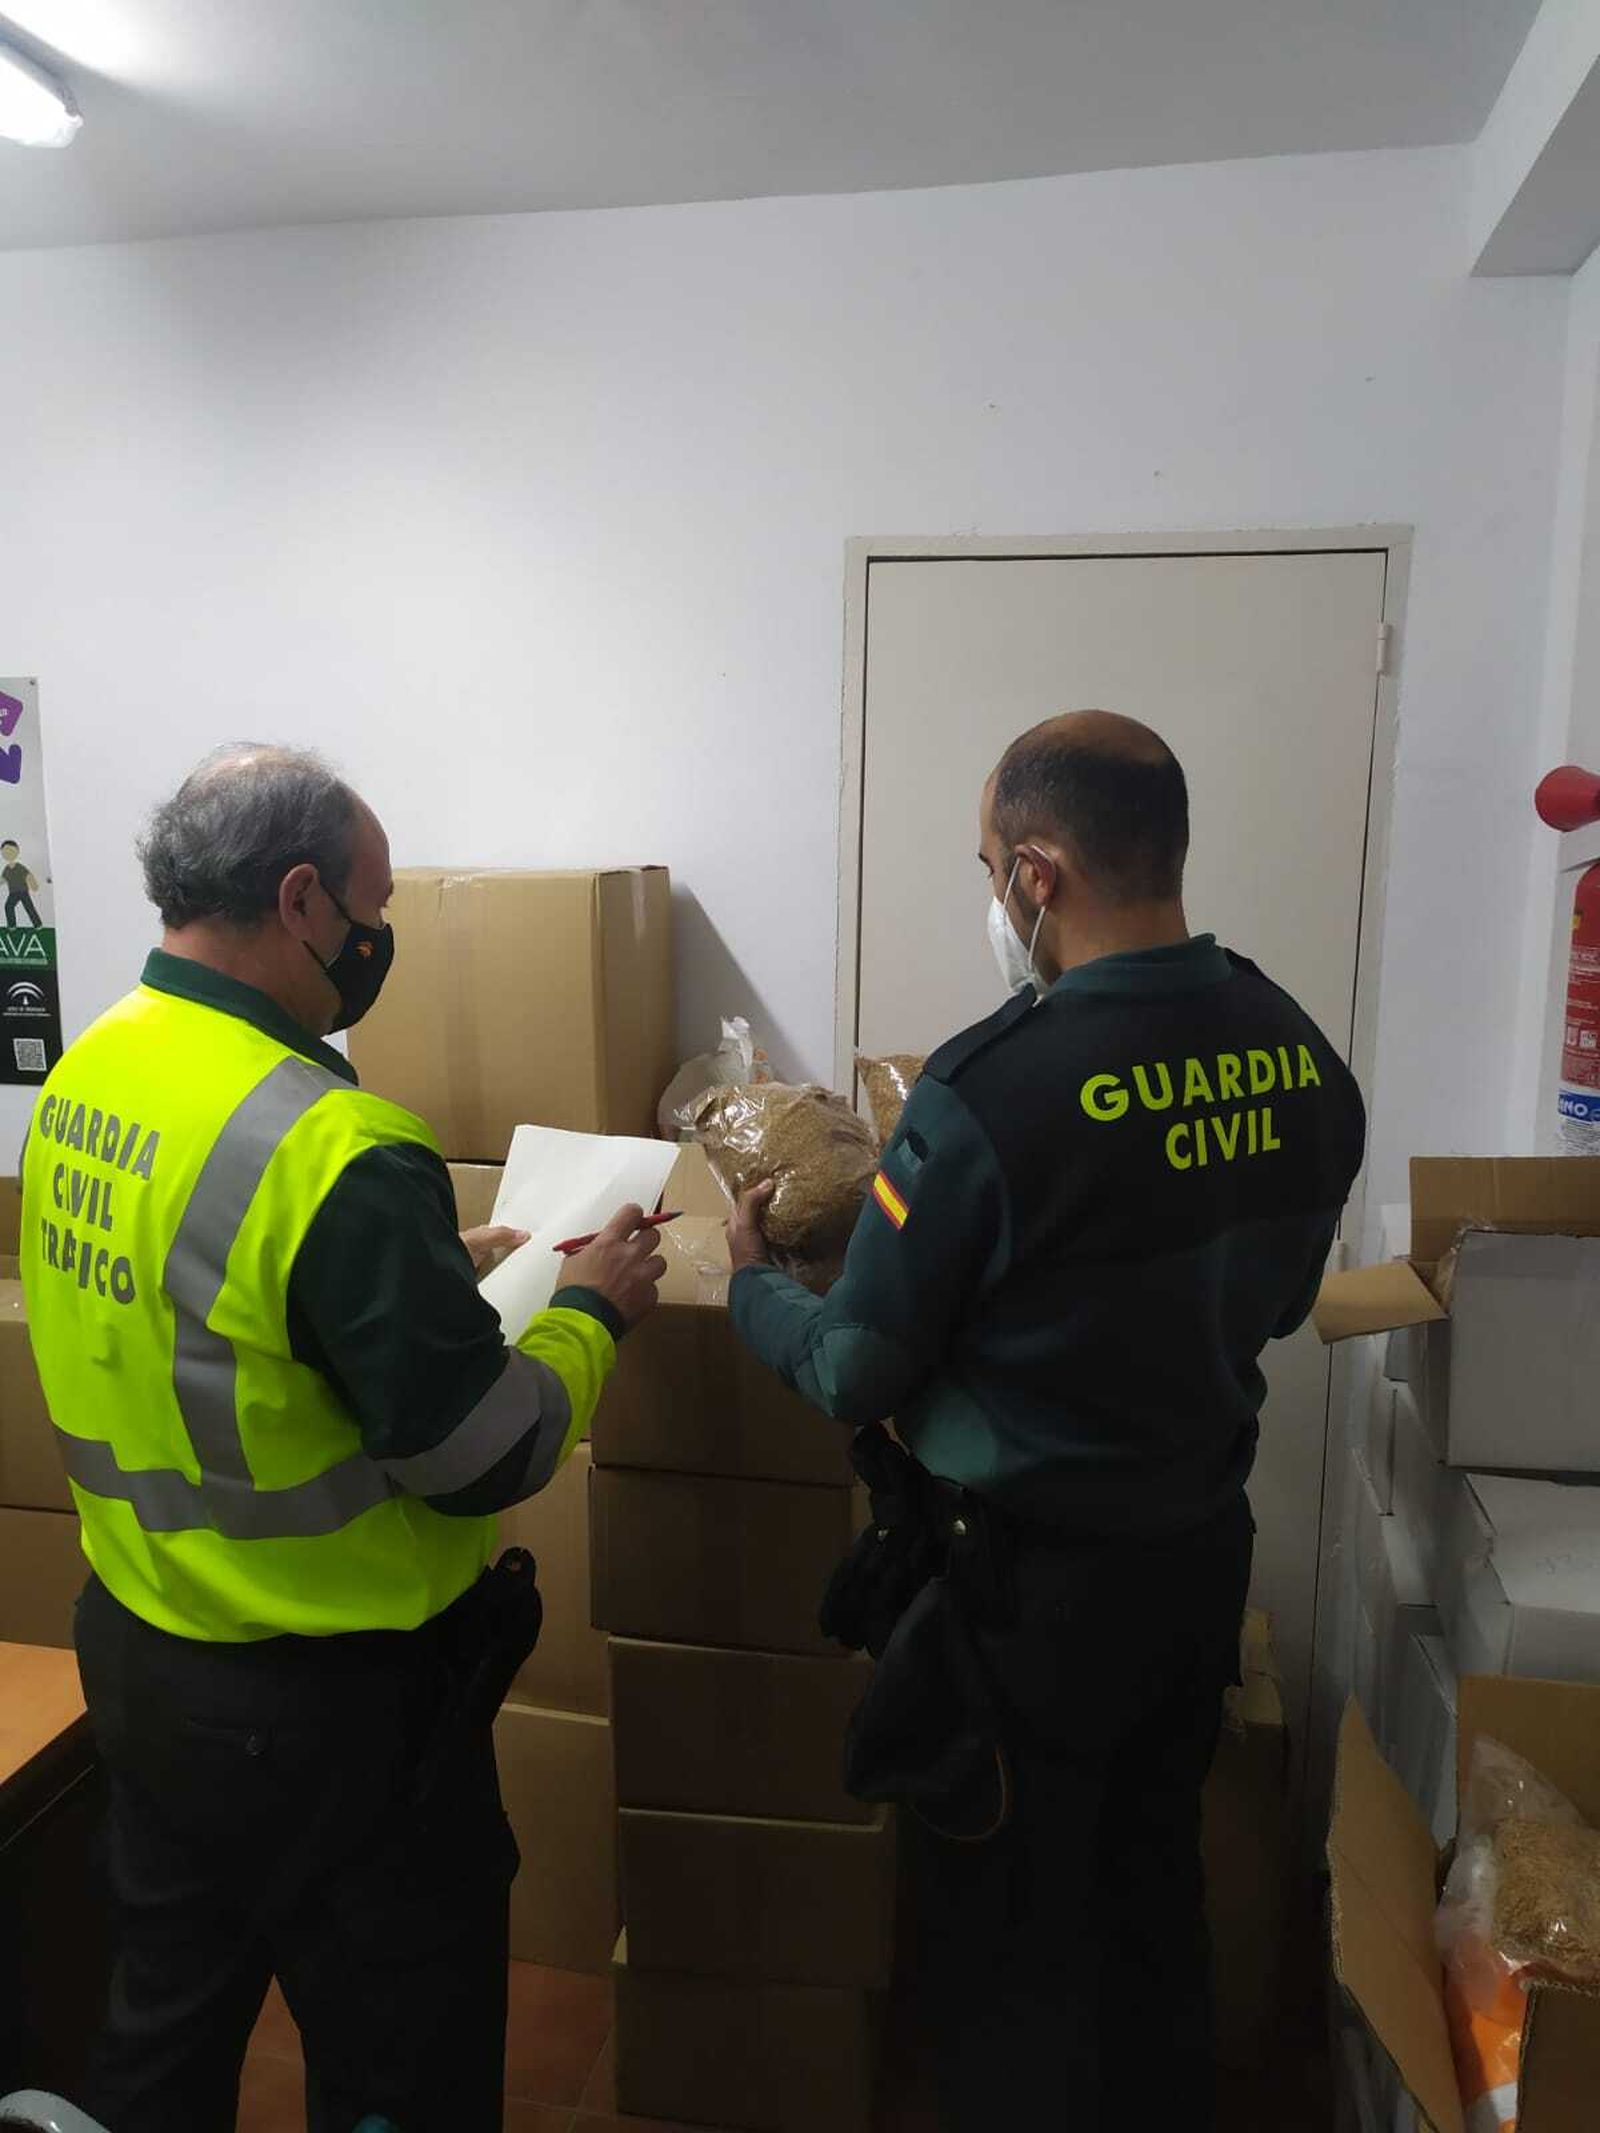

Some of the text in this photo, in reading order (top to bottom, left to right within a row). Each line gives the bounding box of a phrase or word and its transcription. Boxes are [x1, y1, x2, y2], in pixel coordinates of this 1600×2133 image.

[1080, 1044, 1321, 1121] GUARDIA
[39, 1093, 160, 1180] GUARDIA
[1165, 1107, 1280, 1170] CIVIL
[53, 1162, 113, 1231] CIVIL
[41, 1215, 136, 1304] TRAICO
